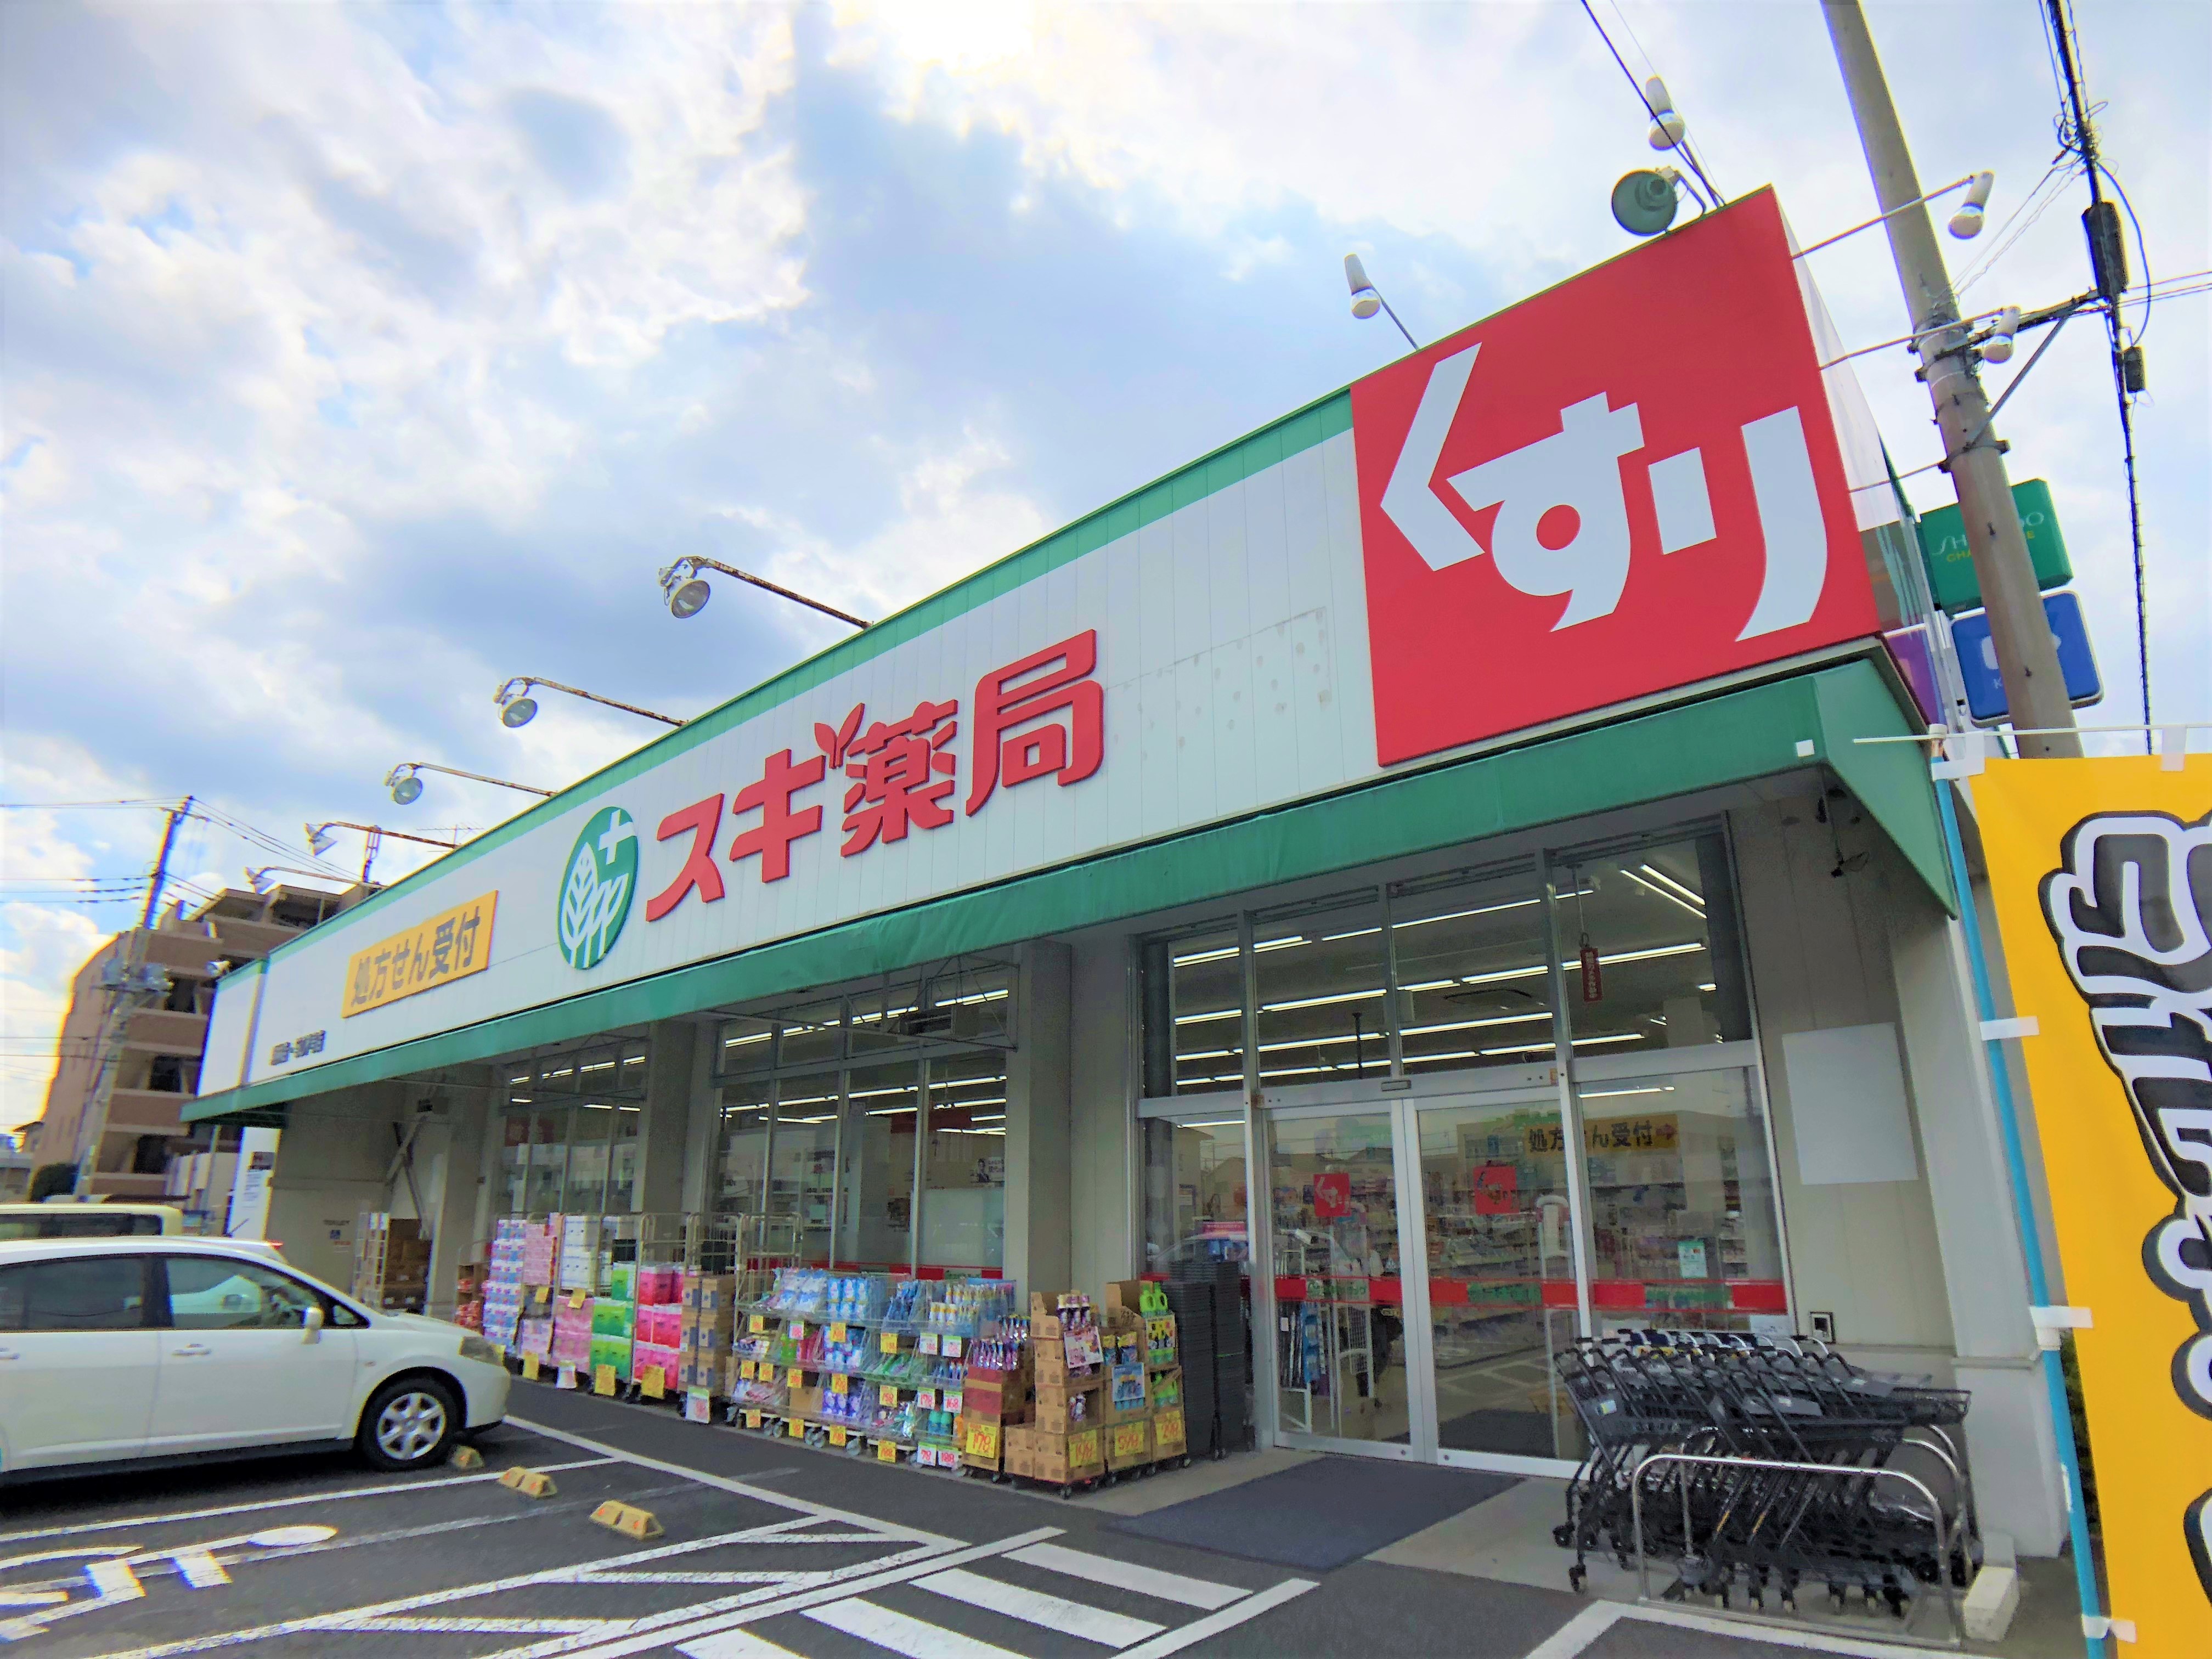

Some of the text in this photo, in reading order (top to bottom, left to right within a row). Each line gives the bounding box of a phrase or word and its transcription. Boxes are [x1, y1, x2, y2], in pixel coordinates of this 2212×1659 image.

[1380, 342, 1827, 642] くすり
[646, 629, 1105, 922] スギ薬局
[351, 906, 480, 1007] 処方せん受付
[1528, 1120, 1652, 1152] 処方ん受付
